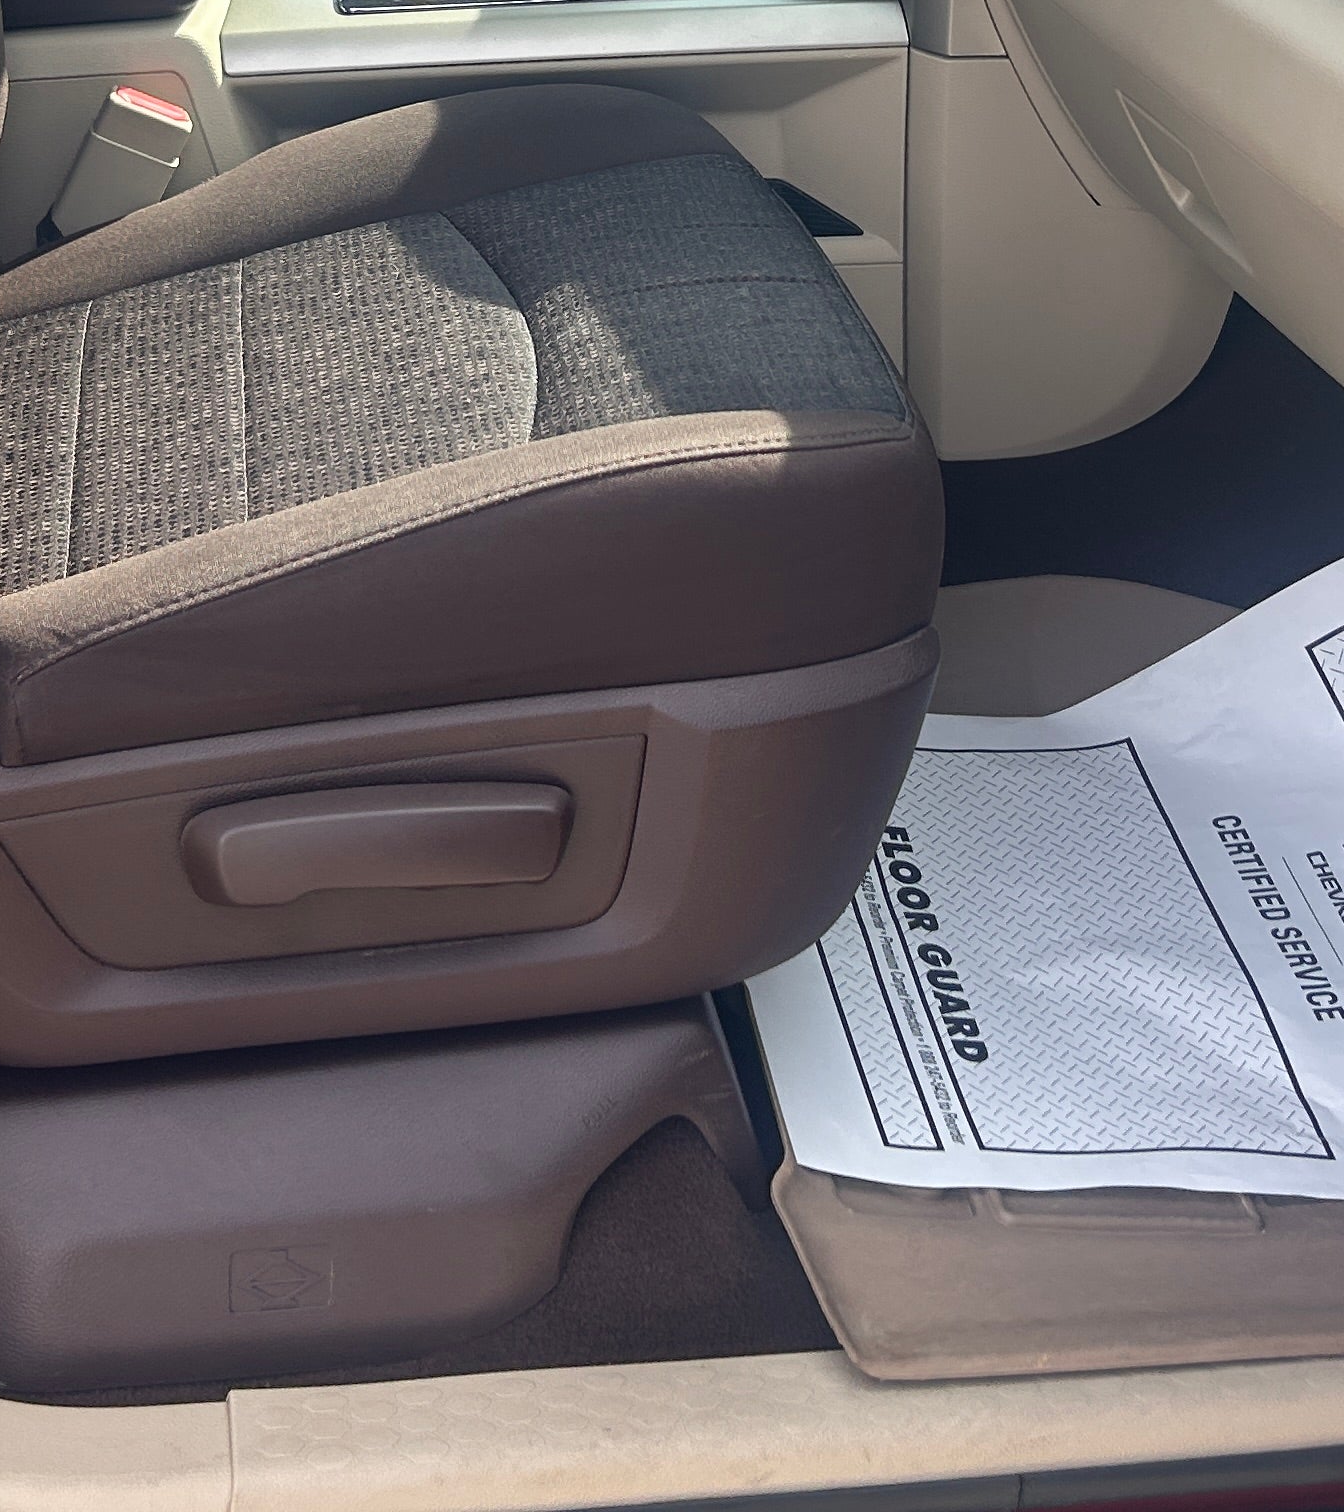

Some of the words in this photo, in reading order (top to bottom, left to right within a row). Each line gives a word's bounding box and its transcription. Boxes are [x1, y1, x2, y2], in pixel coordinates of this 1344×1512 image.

[881, 826, 939, 931] FLOOR
[917, 942, 988, 1063] GUARD
[1212, 815, 1291, 921] CERTIFIED
